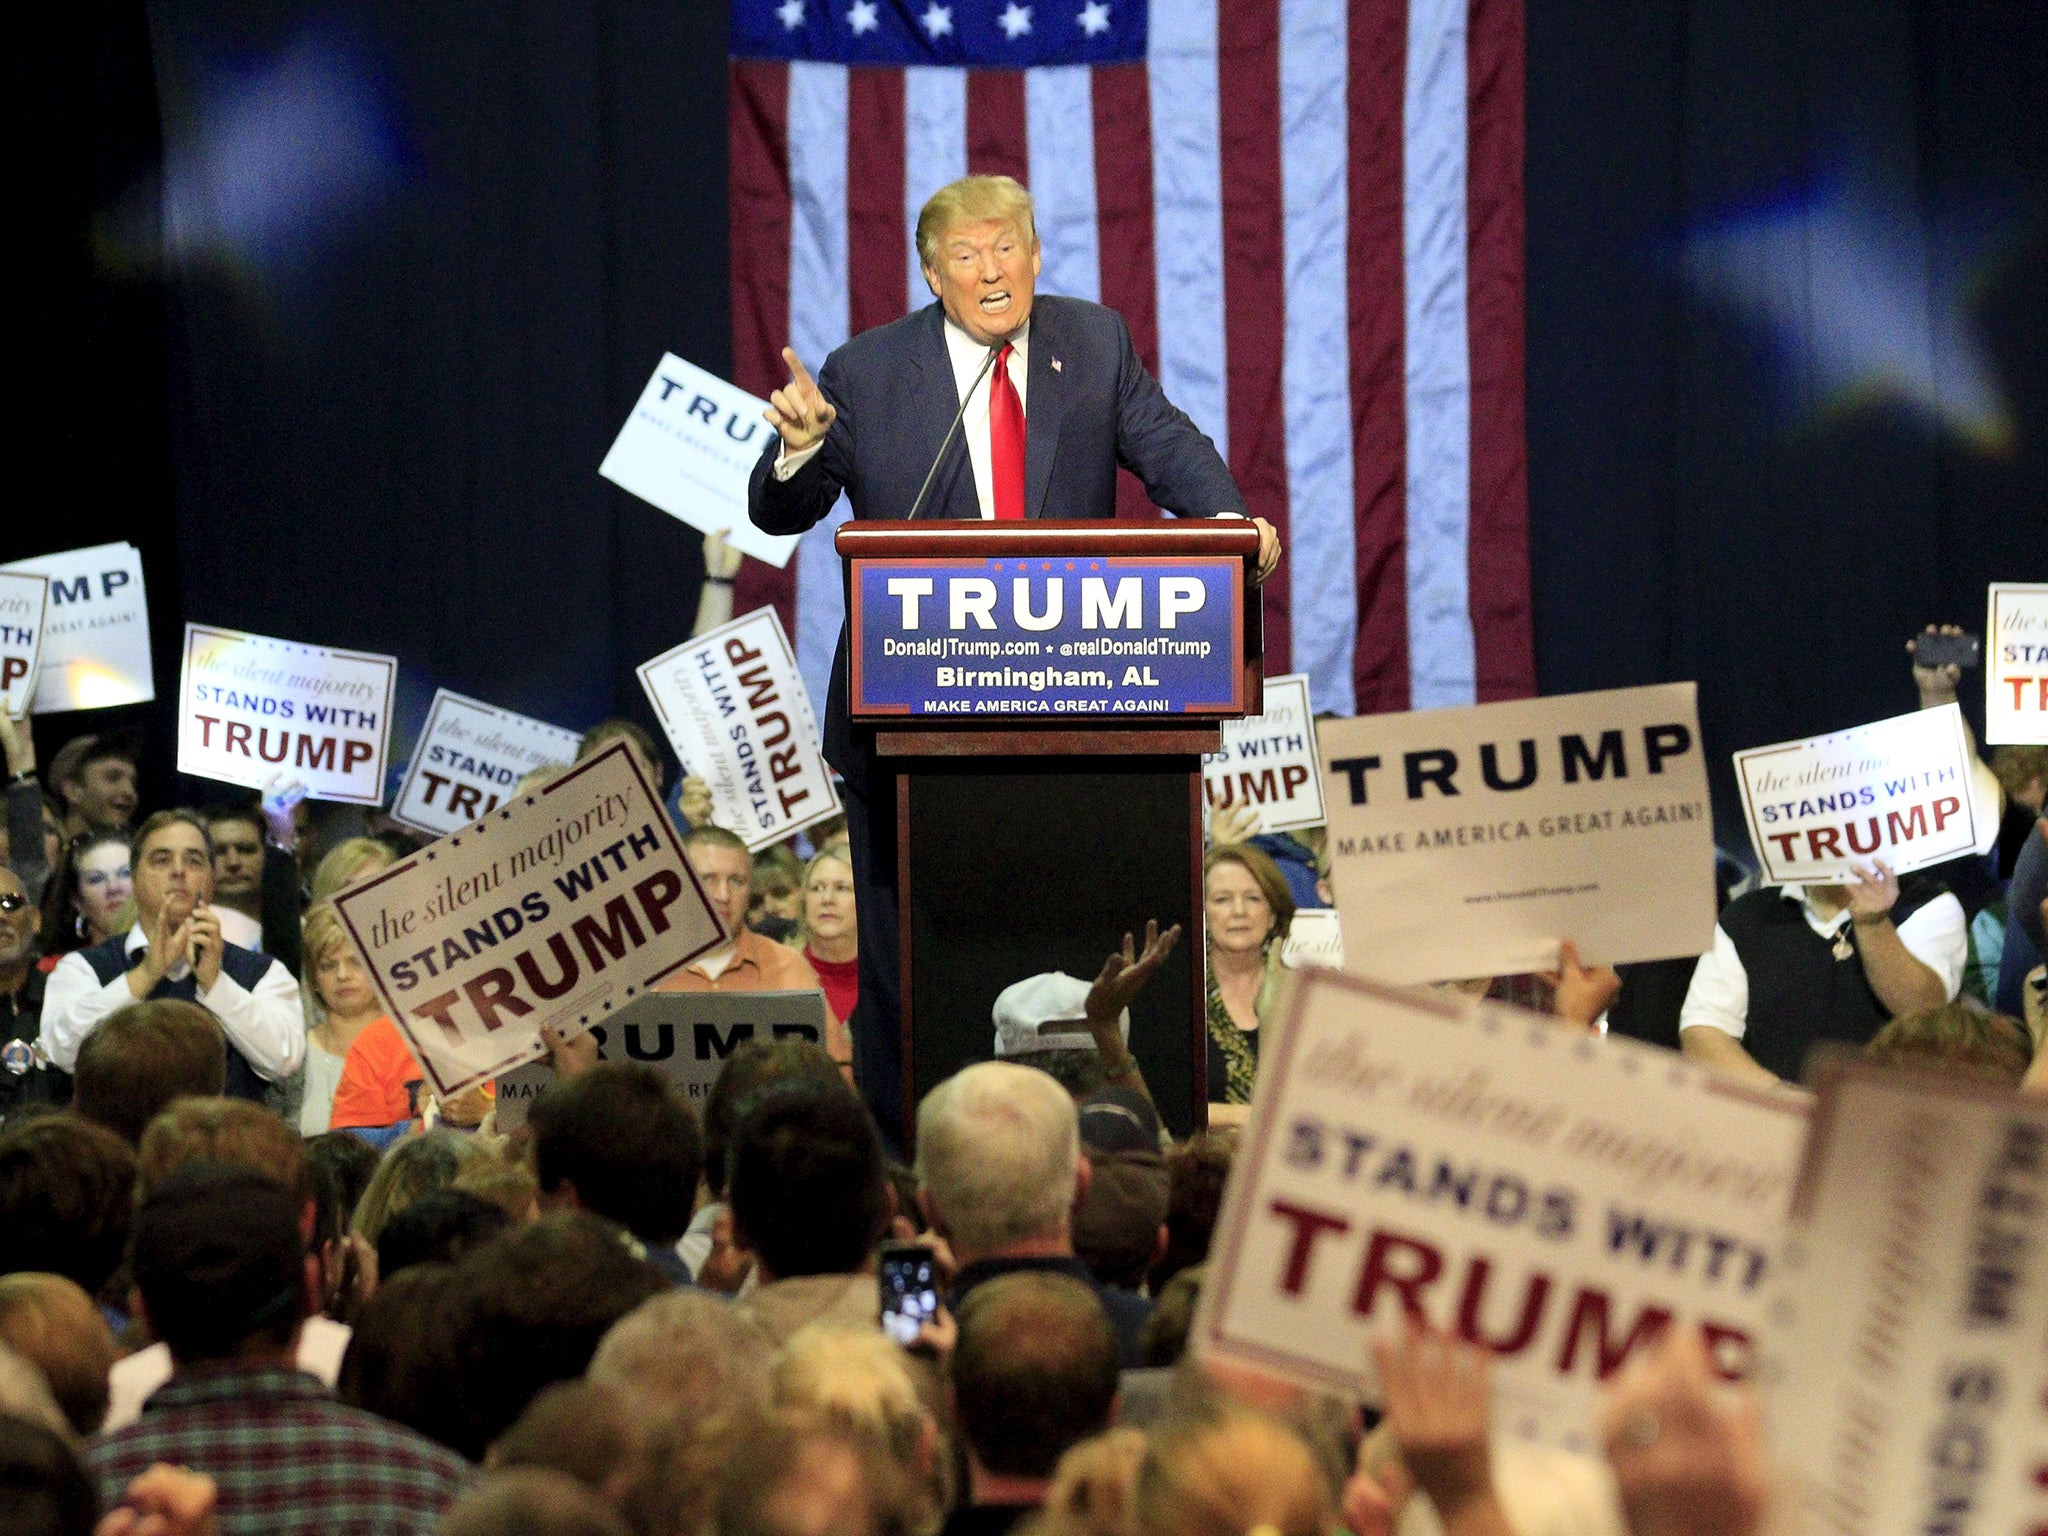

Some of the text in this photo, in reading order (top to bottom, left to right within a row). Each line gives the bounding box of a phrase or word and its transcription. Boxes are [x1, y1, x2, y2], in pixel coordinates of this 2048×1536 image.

[52, 569, 129, 606] MP
[887, 577, 1206, 631] TRUMP
[883, 638, 1211, 660] DonaldJTrump.com @realDonaldTrump
[197, 683, 377, 730] STANDS WITH
[924, 700, 1170, 713] MAKE AMERICA GREAT AGAIN!
[936, 666, 1160, 691] Birmingham, AL
[194, 713, 374, 775] TRUMP
[694, 649, 775, 829] STANDS WITH
[723, 637, 809, 820] TRUMP
[1238, 734, 1302, 759] WITH
[1204, 765, 1308, 810] UMP
[1330, 723, 1693, 806] TRUMP
[1755, 770, 1790, 794] the
[1798, 761, 1851, 787] silent
[1762, 766, 1955, 823] STANDS WITH
[1337, 799, 1702, 856] MAKE AMERICA GREAT AGAIN!
[1767, 796, 1961, 872] TRUMP
[371, 785, 633, 950] the silent majority
[389, 823, 663, 992] STANDS WITH
[409, 868, 684, 1051] TRUMP
[1282, 1116, 1578, 1240] STANDS
[1268, 1198, 1758, 1382] TRUMP
